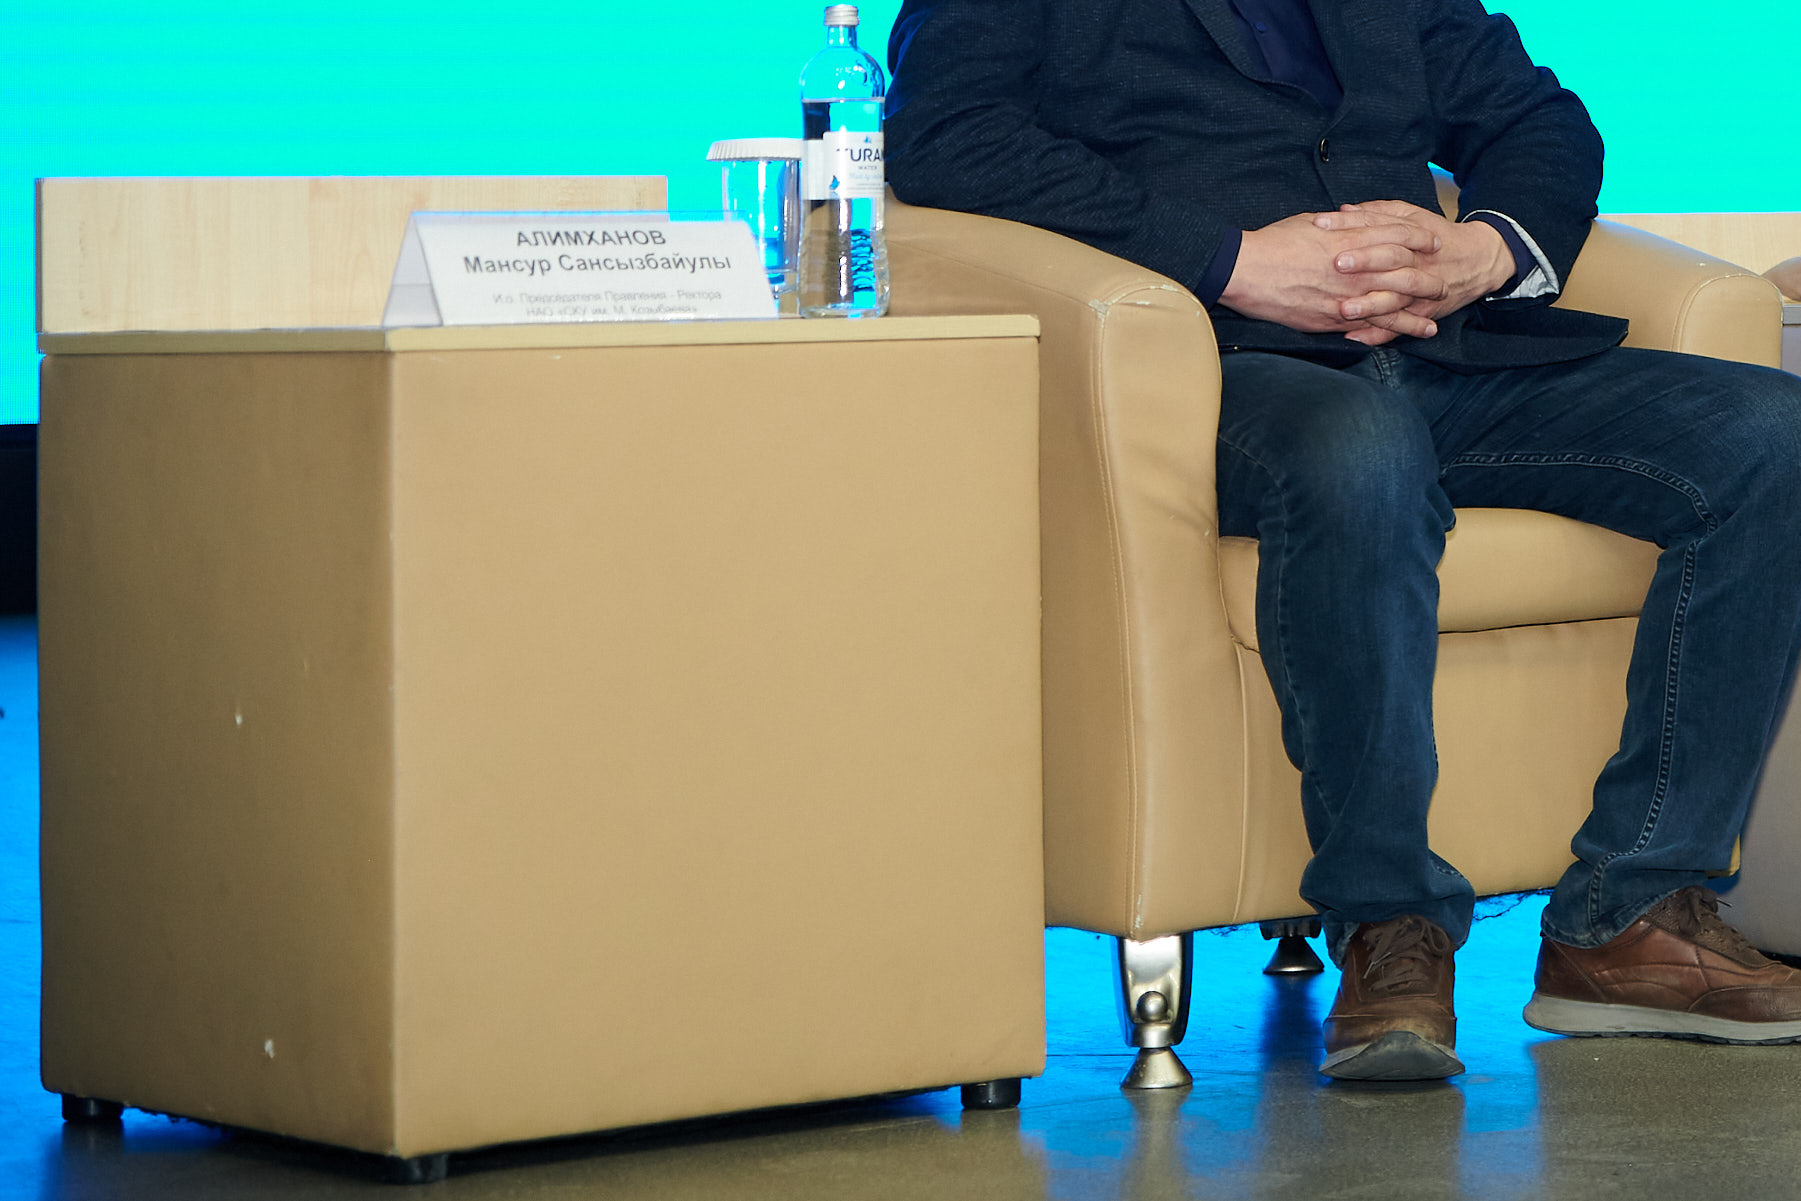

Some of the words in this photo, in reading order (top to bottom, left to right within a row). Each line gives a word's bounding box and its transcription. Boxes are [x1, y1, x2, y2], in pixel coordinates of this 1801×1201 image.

[515, 229, 667, 247] АЛИМХАНОВ
[462, 255, 552, 277] Мансур
[558, 252, 732, 276] Сансызбайулы
